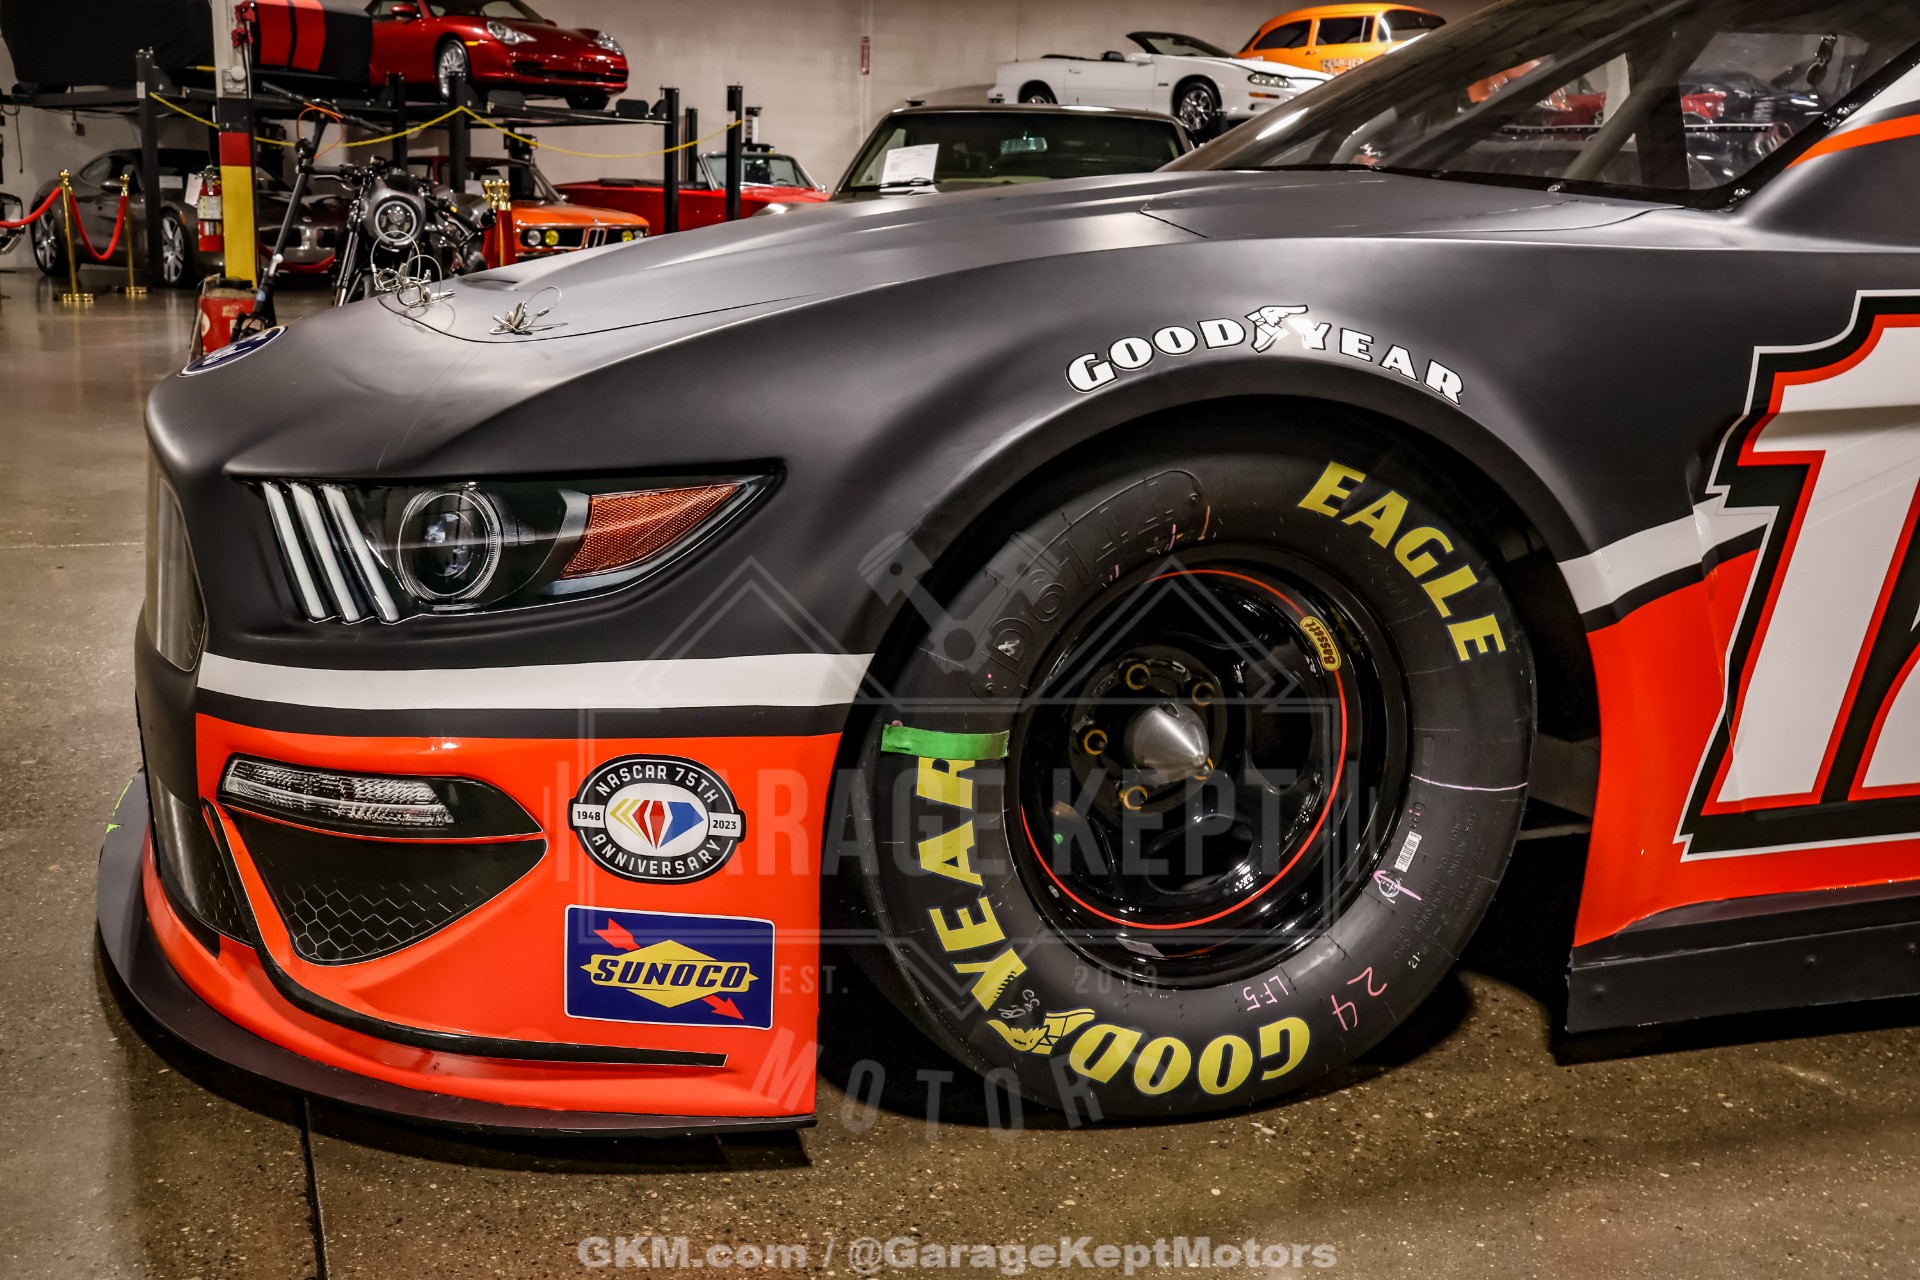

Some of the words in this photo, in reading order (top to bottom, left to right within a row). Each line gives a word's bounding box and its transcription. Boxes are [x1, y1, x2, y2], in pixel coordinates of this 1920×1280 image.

[1297, 461, 1506, 662] EAGLE
[1303, 621, 1336, 665] Bassett
[595, 764, 667, 797] NASCAR
[674, 767, 719, 803] 75TH
[576, 810, 601, 821] 1948
[712, 819, 737, 830] 2023
[592, 833, 721, 875] ANNIVERSARY
[593, 959, 748, 988] SUNOCO
[1331, 966, 1388, 1032] 24
